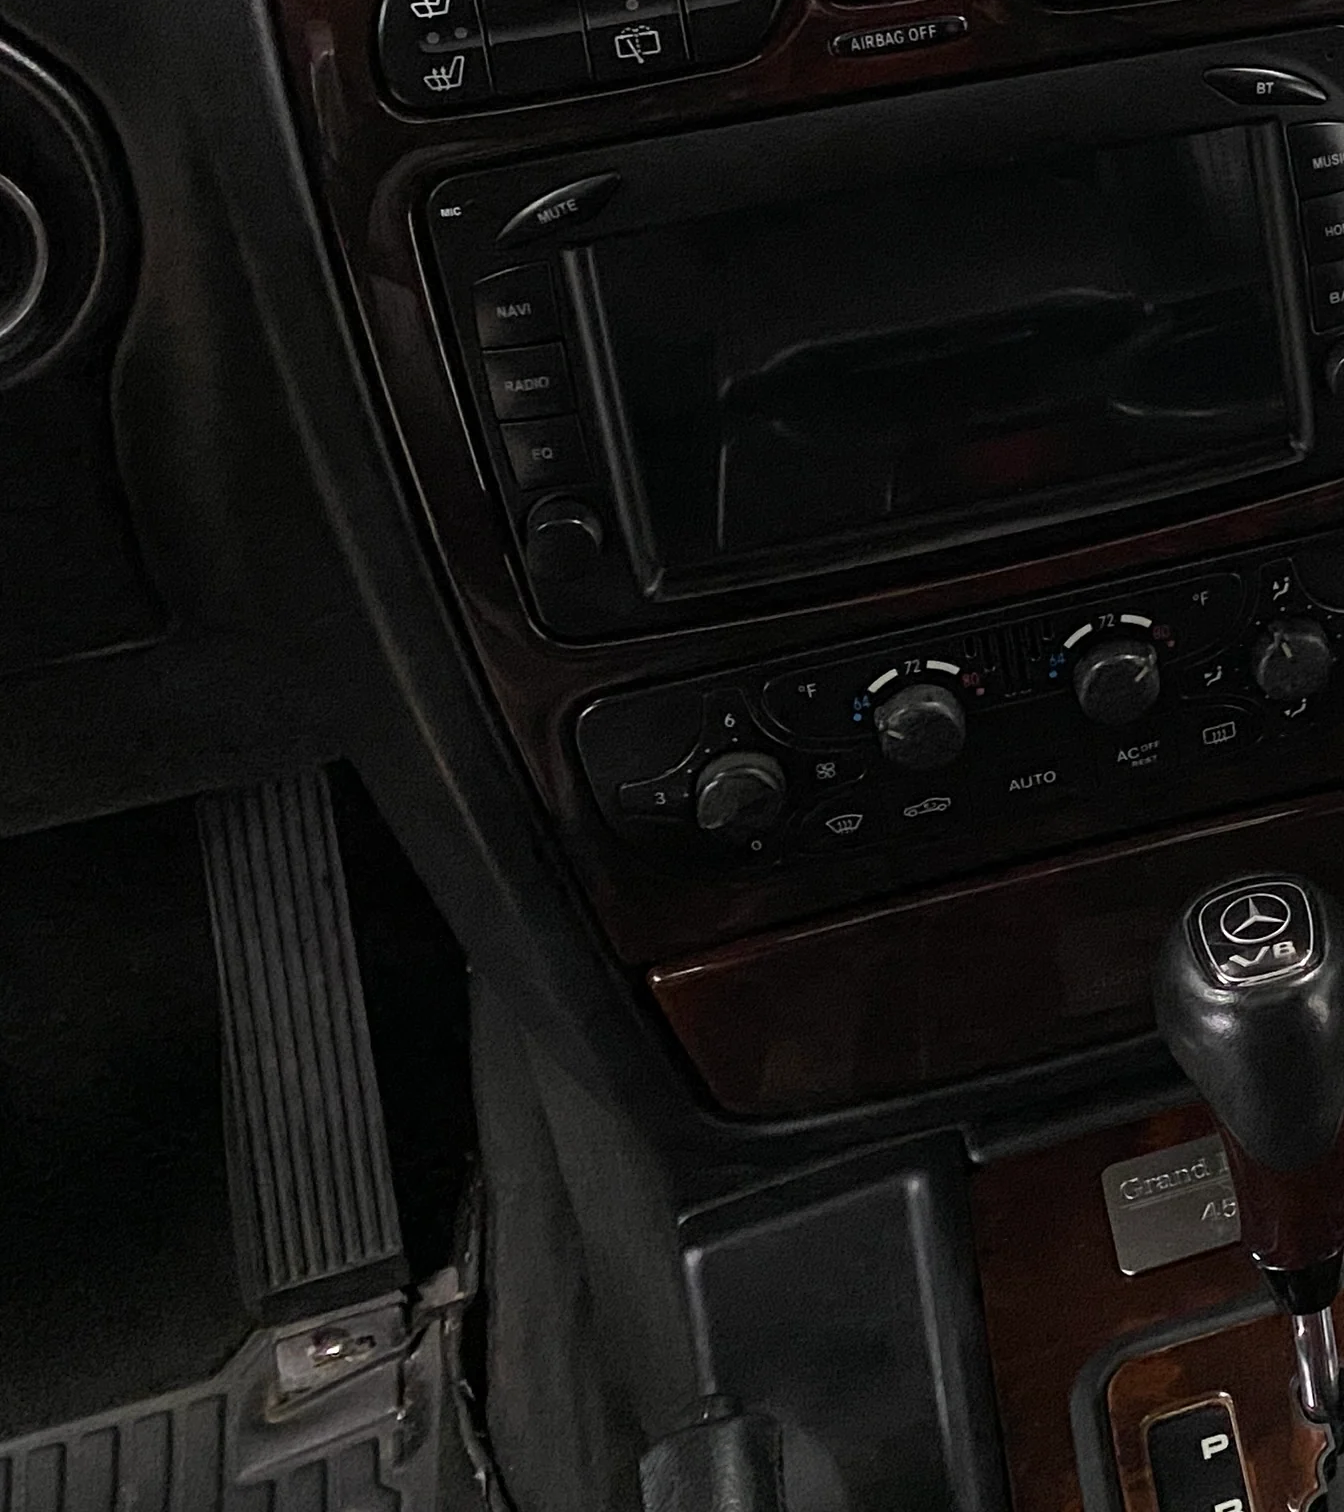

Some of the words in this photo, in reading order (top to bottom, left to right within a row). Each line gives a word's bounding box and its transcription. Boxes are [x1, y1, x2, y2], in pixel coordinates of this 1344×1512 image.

[850, 30, 905, 52] AIRBAG
[908, 24, 937, 41] OFF
[1255, 81, 1275, 95] BT
[439, 206, 462, 218] MIC
[536, 198, 580, 225] MUTE
[496, 302, 532, 319] NAVI
[503, 375, 550, 393] RADIO
[531, 447, 554, 461] EQ
[1098, 613, 1115, 630] 72
[1152, 623, 1172, 640] 80
[904, 659, 922, 675] 72
[960, 672, 982, 688] 80
[724, 713, 736, 729] 6
[1116, 746, 1140, 763] AC
[1140, 739, 1161, 754] OFF
[1008, 769, 1057, 793] AUTO
[654, 792, 667, 806] 3
[1228, 940, 1299, 968] V8
[1119, 1157, 1211, 1200] Grand
[1201, 1434, 1229, 1460] P
